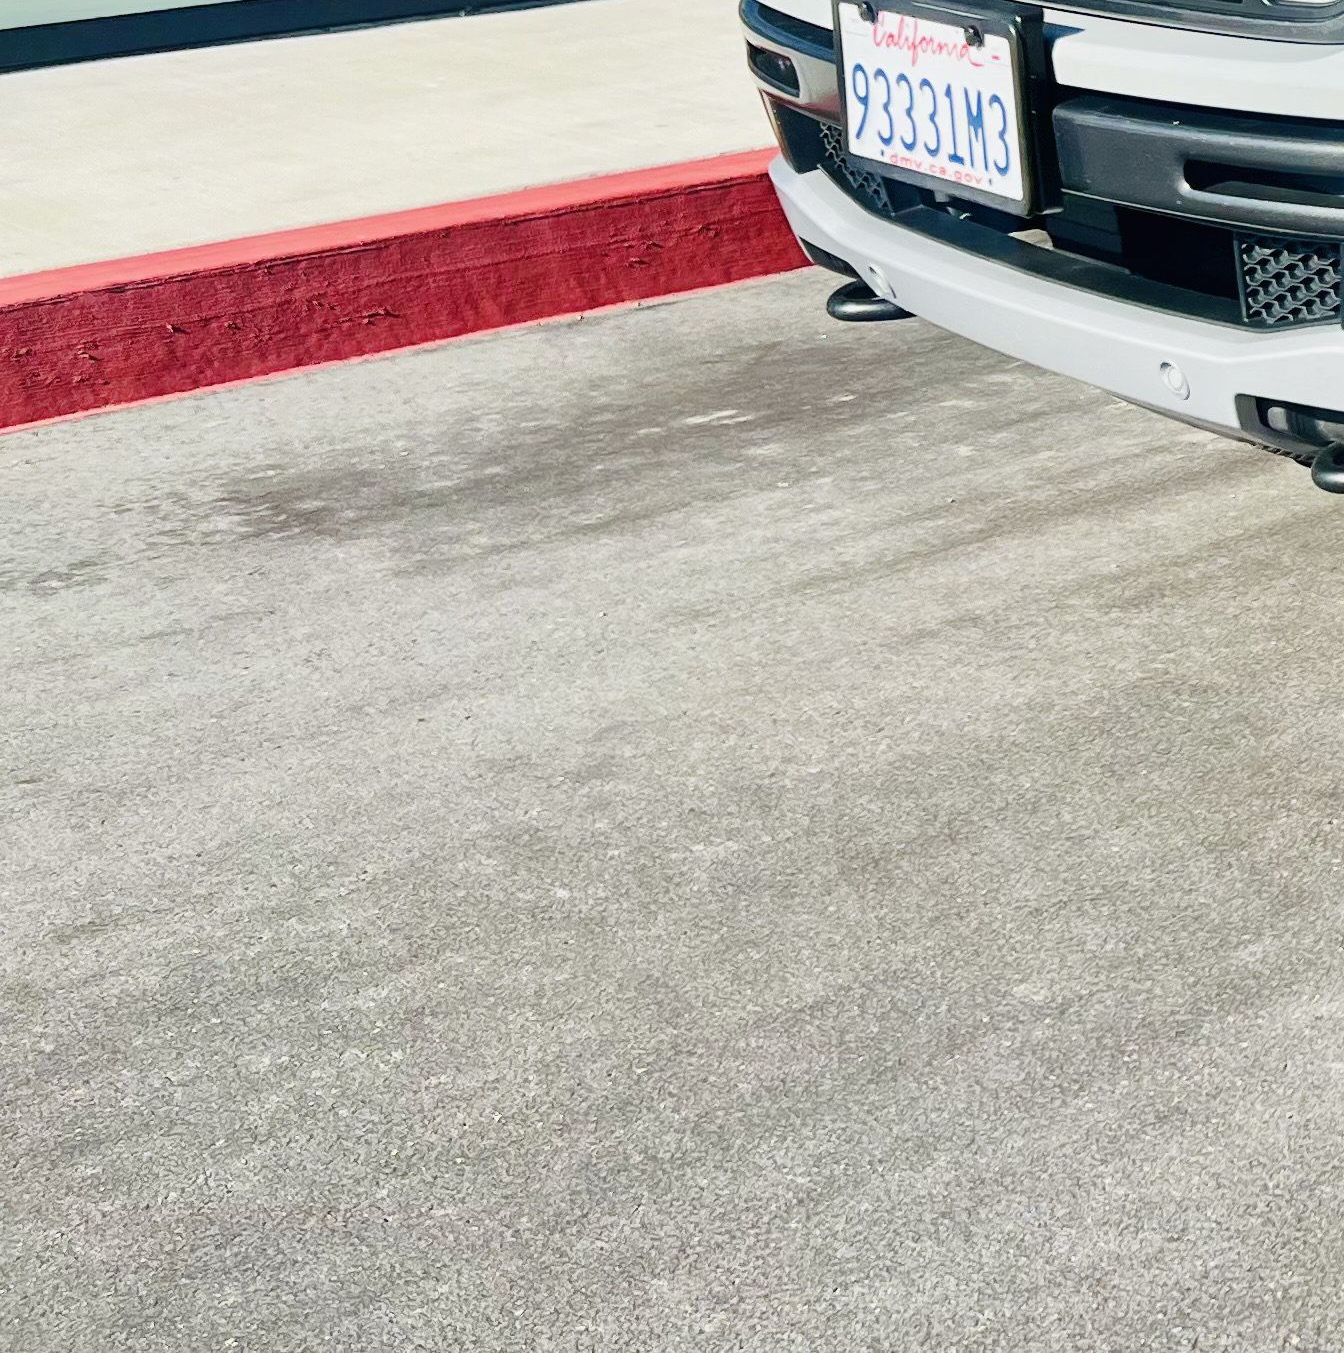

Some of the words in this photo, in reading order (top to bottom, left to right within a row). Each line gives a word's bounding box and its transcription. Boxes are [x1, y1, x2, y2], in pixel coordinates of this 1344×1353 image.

[872, 10, 985, 67] California
[852, 62, 1010, 177] 93331M3
[889, 152, 982, 185] dmv.ca.gov
